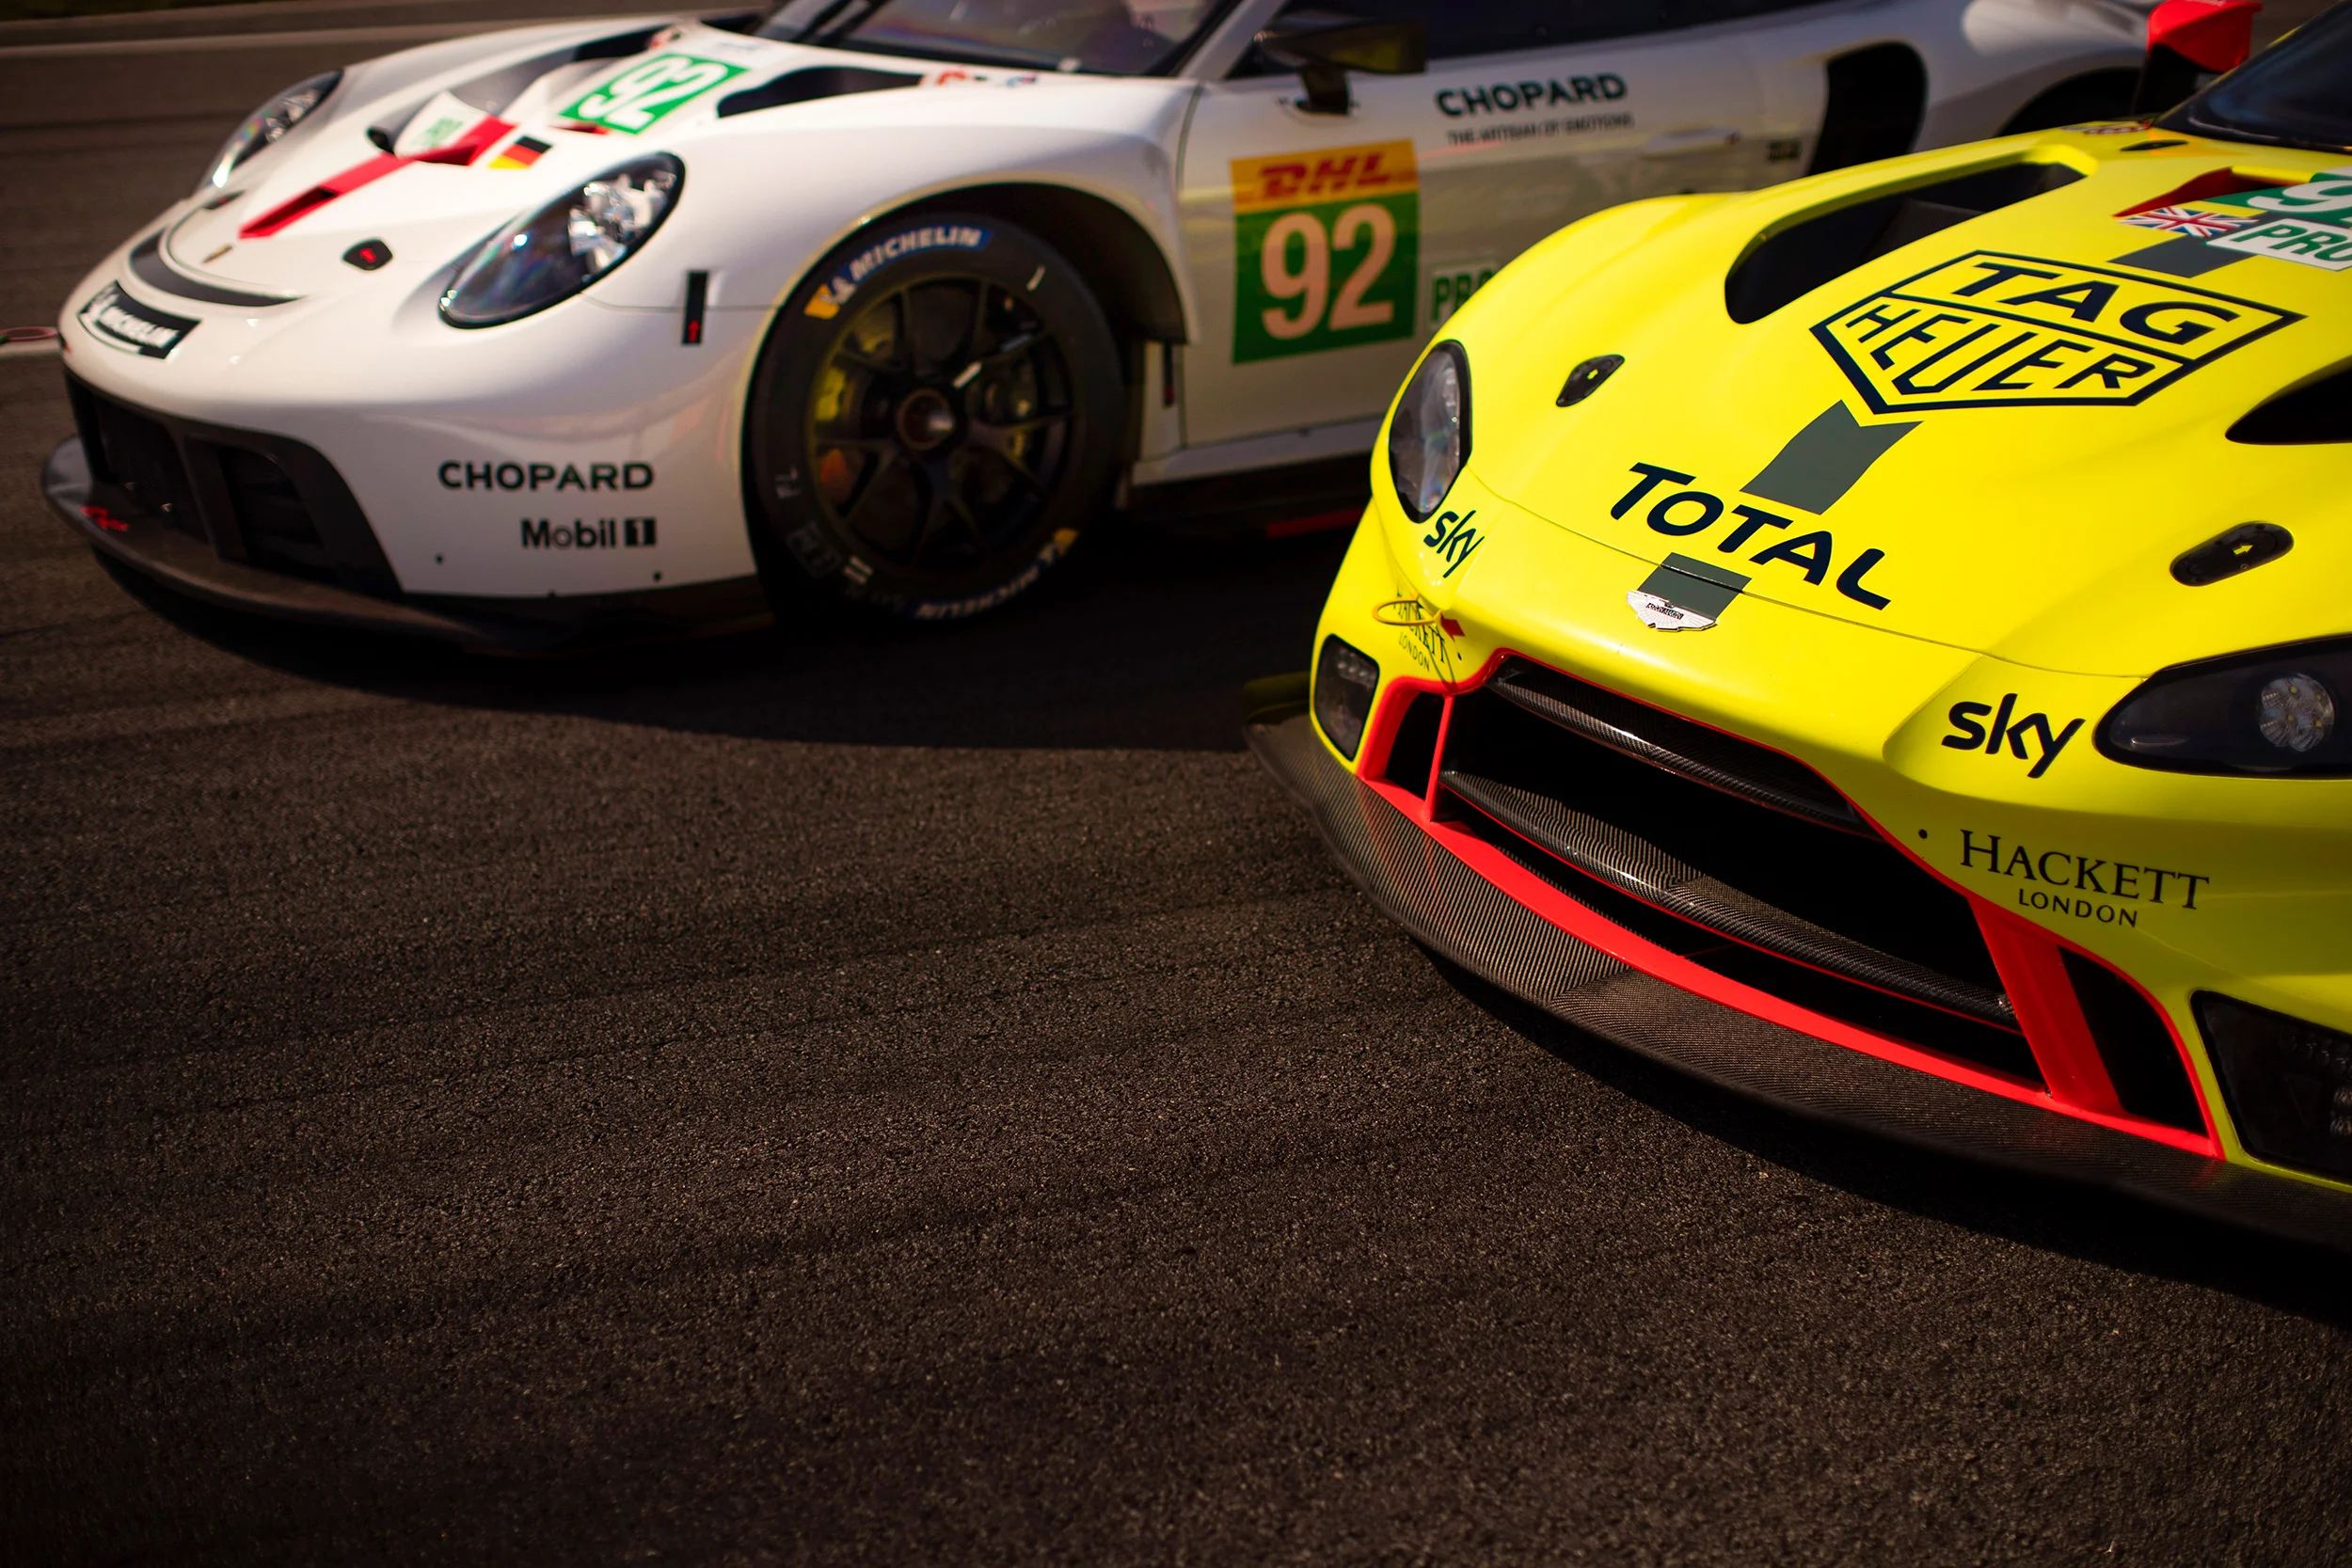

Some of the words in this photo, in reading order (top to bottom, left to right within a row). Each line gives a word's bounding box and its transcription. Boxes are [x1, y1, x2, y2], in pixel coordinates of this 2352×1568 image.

[577, 56, 729, 131] 92
[1436, 72, 1627, 117] CHOPARD
[1262, 152, 1390, 199] DHL
[2247, 180, 2352, 221] 9
[850, 227, 981, 280] MICHELIN
[1261, 203, 1395, 341] 92
[1951, 261, 2241, 345] TAG
[1845, 303, 2155, 395] HEUER
[438, 460, 655, 491] CHOPARD
[520, 518, 617, 548] Mobil
[1422, 509, 1486, 578] sky
[1610, 461, 1892, 610] TOTAL
[1941, 693, 2086, 779] sky
[1960, 829, 2210, 911] HACKETT
[2018, 888, 2137, 928] LONDON
